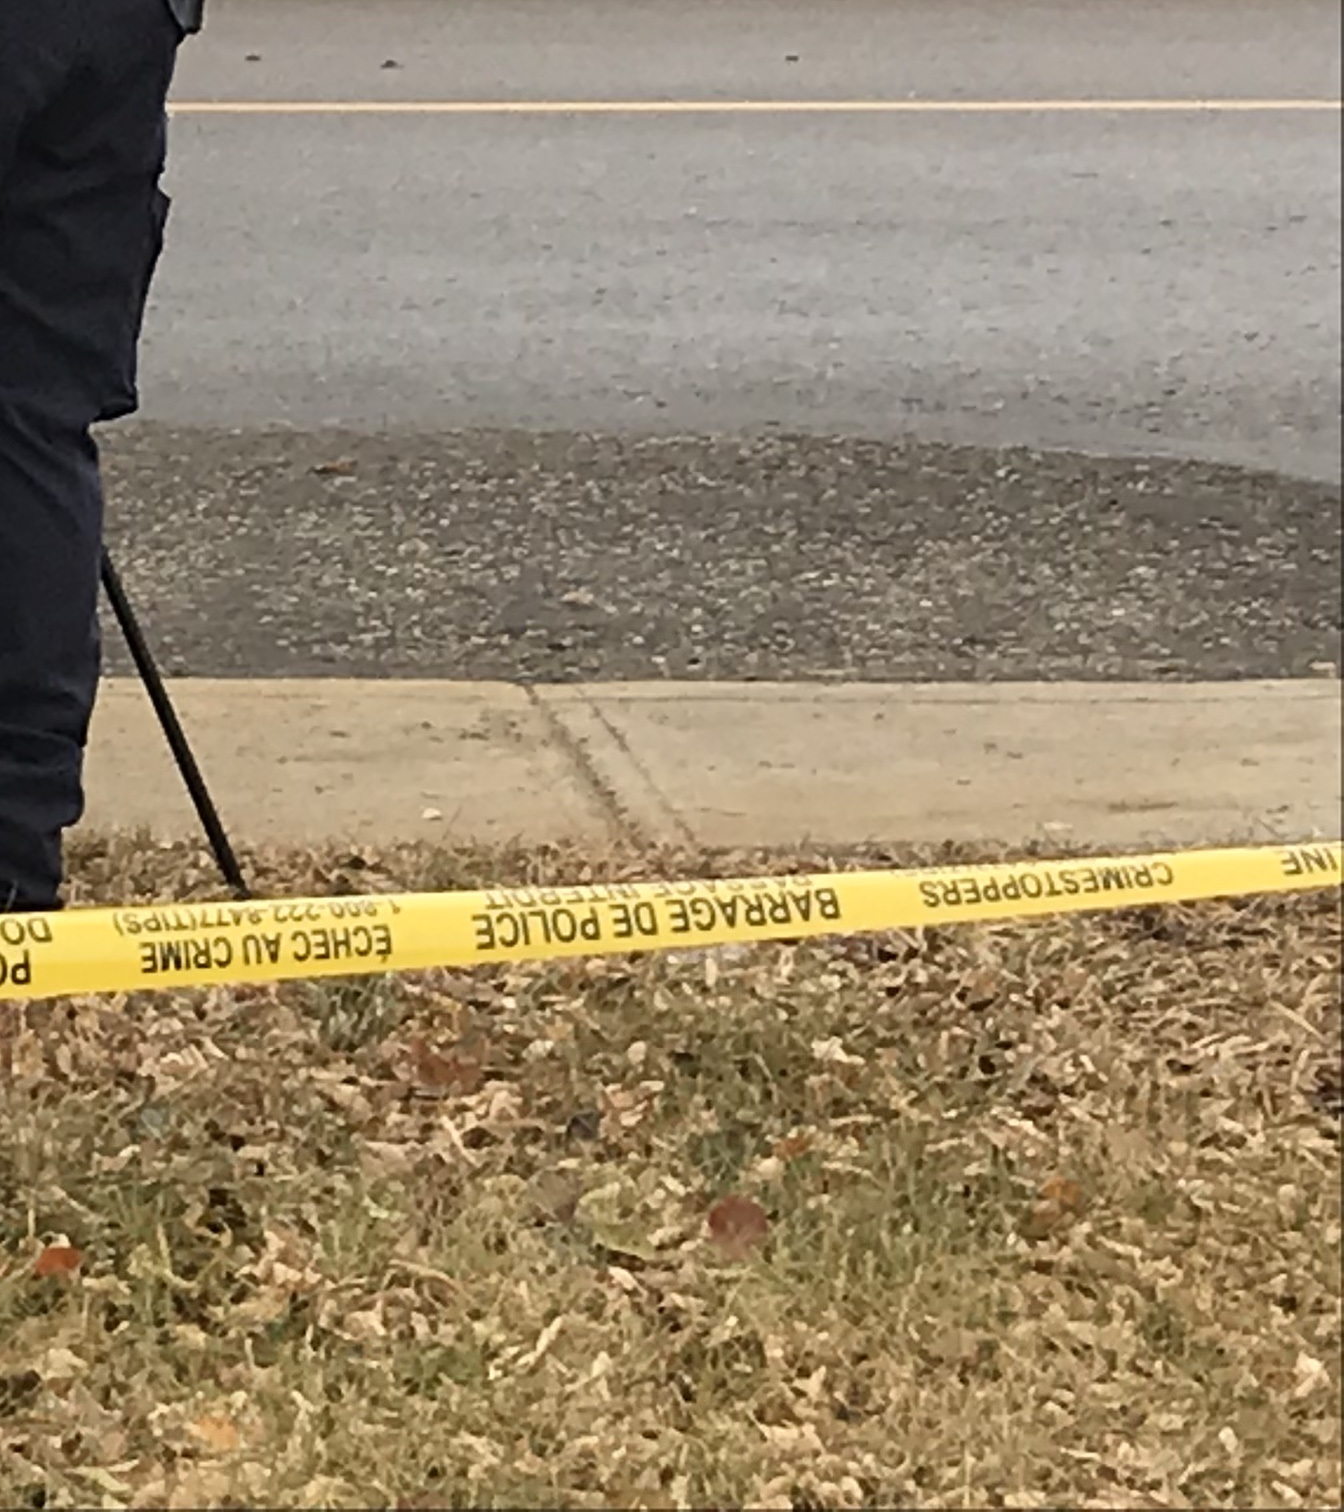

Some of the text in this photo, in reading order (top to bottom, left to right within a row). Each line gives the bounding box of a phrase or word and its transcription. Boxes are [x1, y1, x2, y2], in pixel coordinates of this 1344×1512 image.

[920, 862, 1174, 908] CRIMESTOPPERS
[0, 917, 52, 944] DO
[472, 907, 600, 950] POLICE
[613, 903, 658, 938] DE
[668, 887, 840, 933] BARRAGE
[141, 923, 394, 974] ÉCHEC AU CRIME
